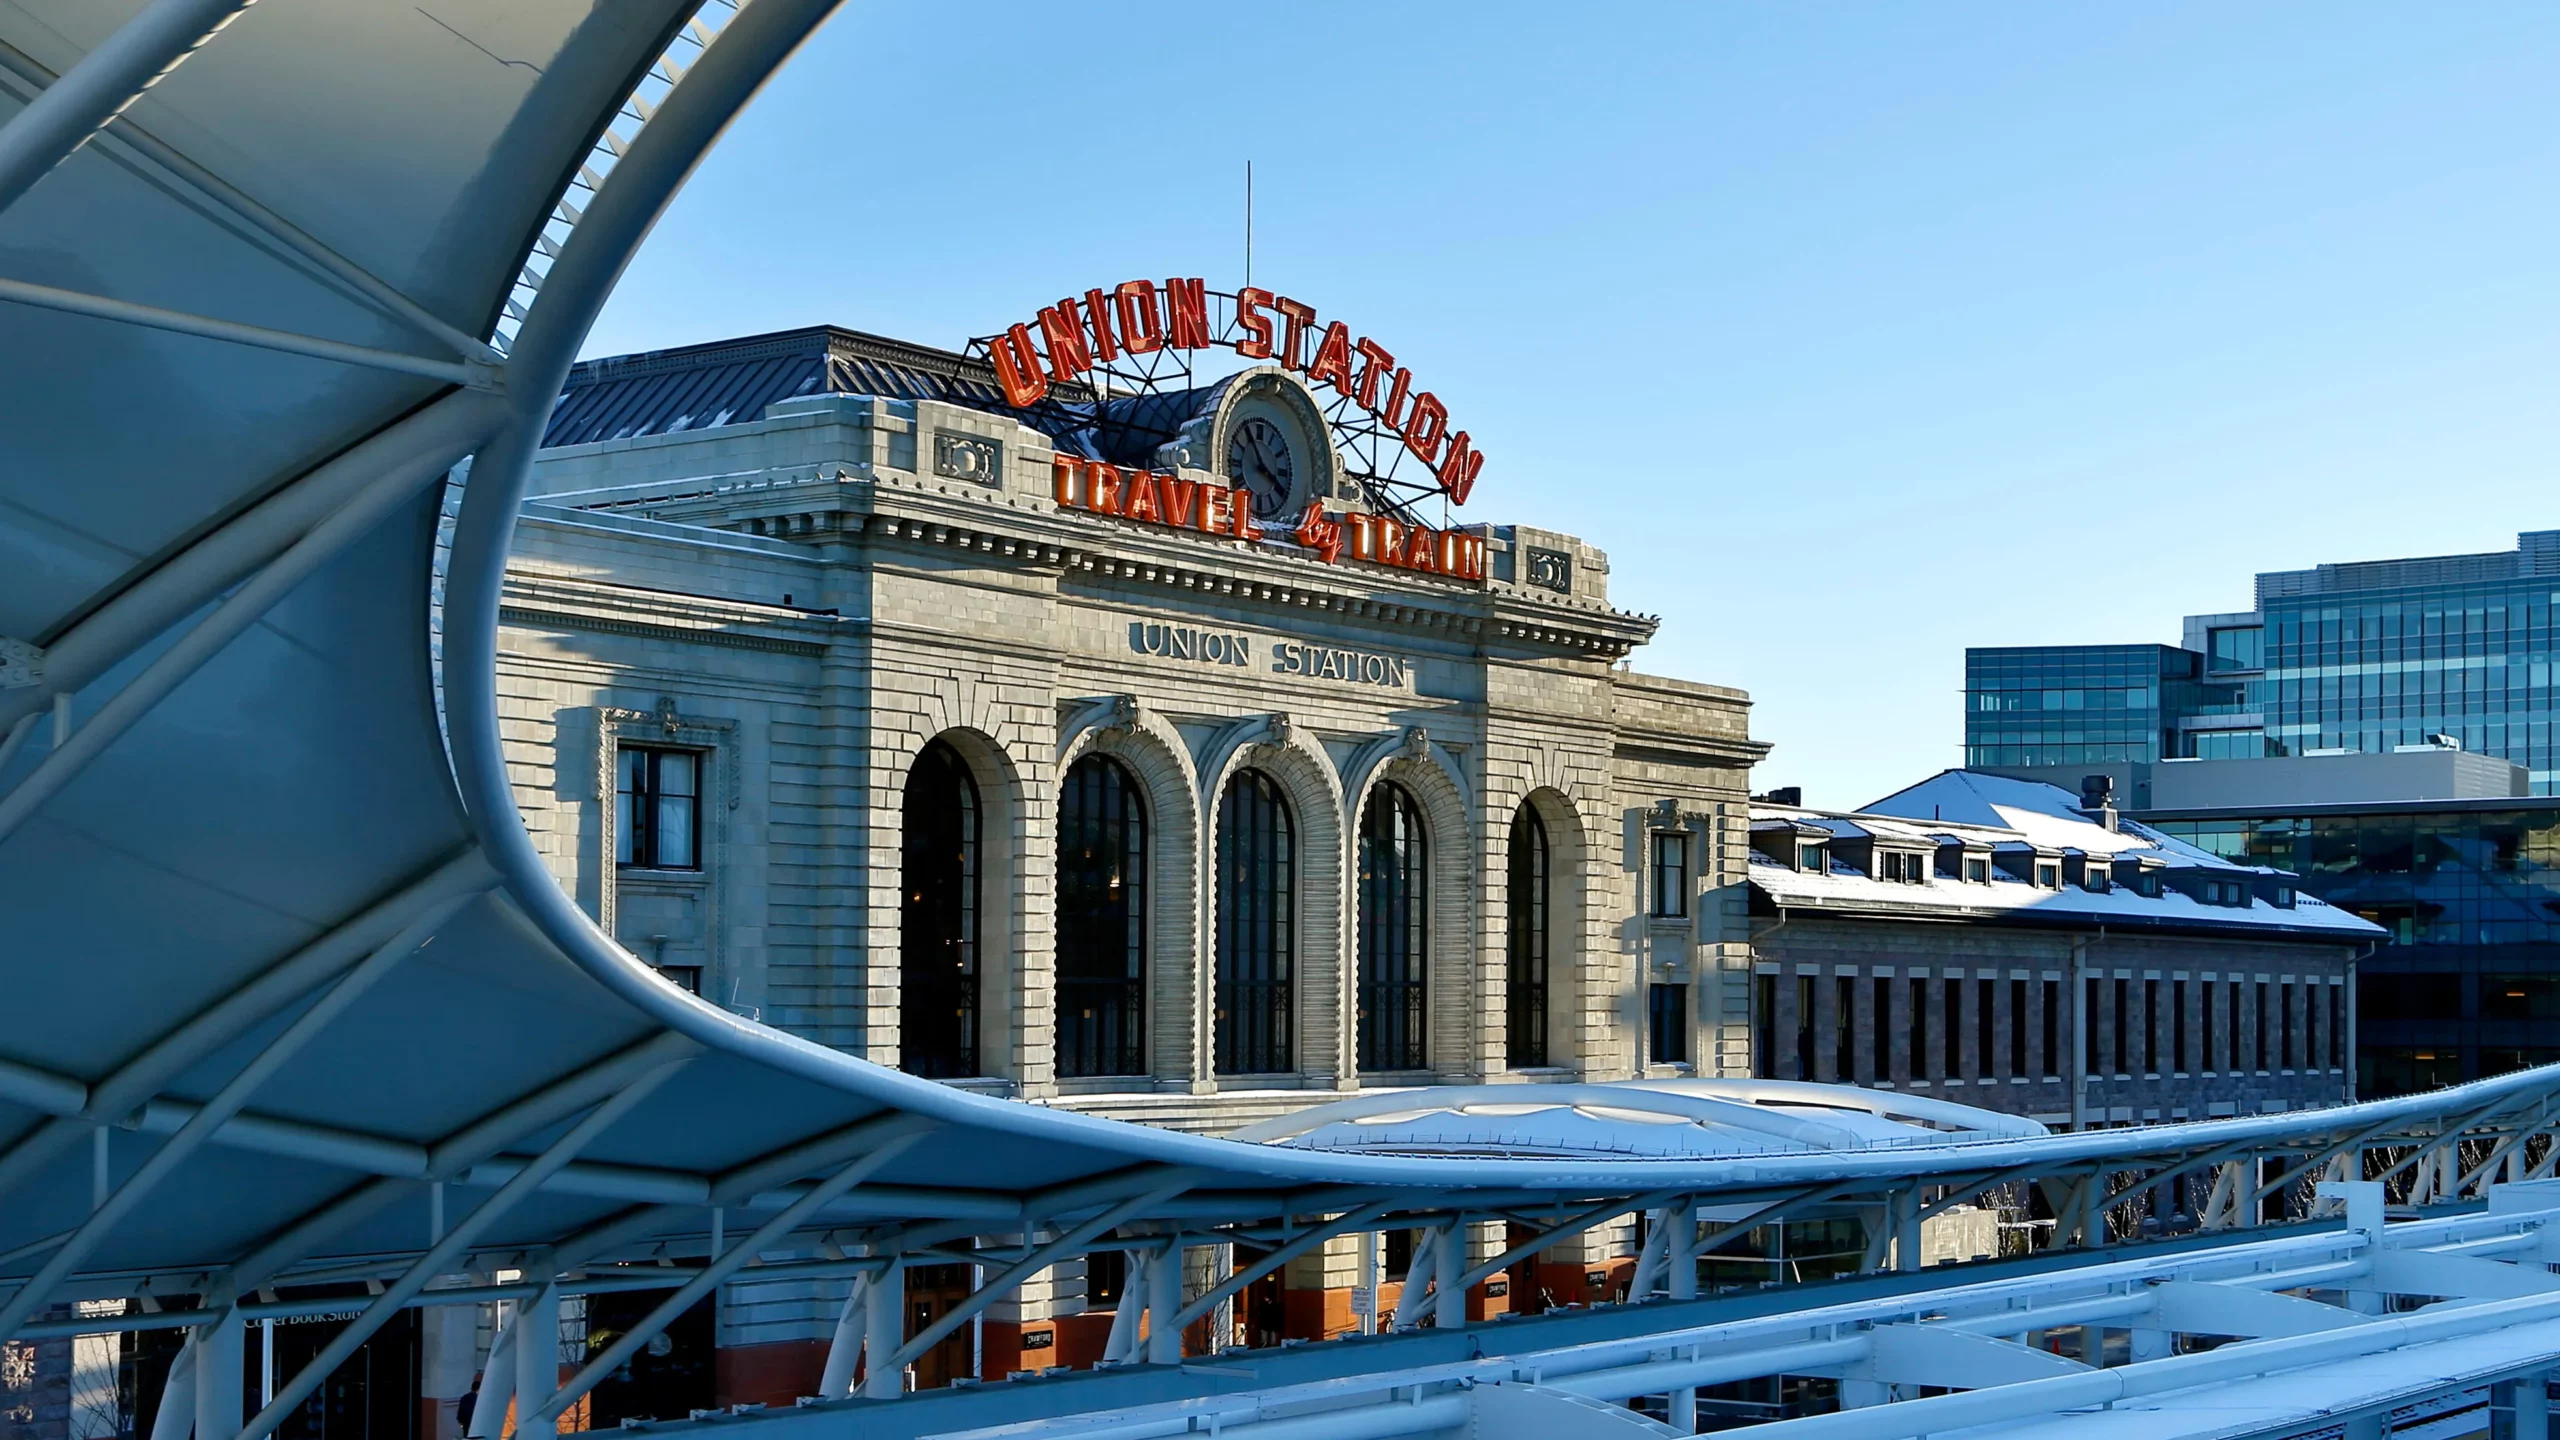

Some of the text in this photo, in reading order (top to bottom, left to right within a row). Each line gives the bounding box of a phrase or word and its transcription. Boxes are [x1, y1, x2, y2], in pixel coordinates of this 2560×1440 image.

[989, 278, 1210, 408] UNION
[1236, 287, 1485, 506] STATION
[1054, 453, 1265, 541] TRAVEL
[1296, 501, 1343, 565] by
[1346, 512, 1486, 580] TRAIN
[1132, 622, 1405, 687] UNION STATION
[244, 1316, 286, 1328] Coer
[329, 1311, 361, 1322] Stor
